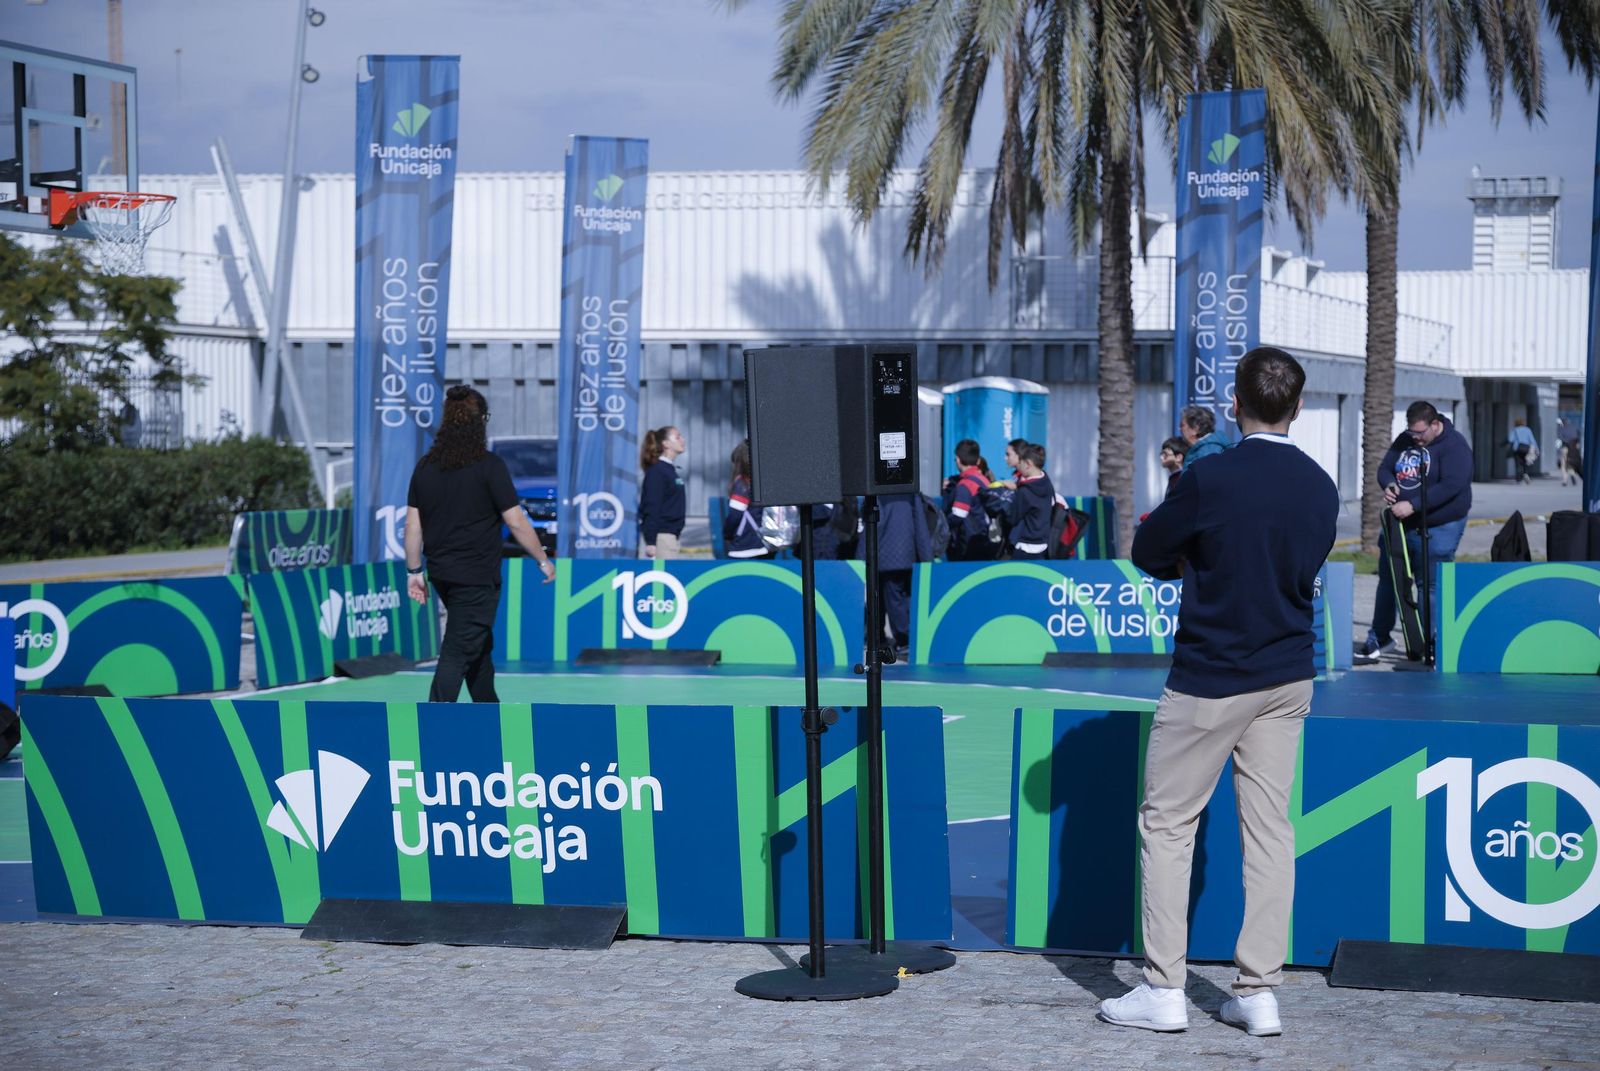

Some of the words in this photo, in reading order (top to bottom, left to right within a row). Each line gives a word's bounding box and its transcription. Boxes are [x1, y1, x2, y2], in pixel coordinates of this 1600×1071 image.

[369, 142, 452, 161] Fundación
[381, 159, 442, 180] Unicaja
[1187, 168, 1260, 187] Fundación
[1197, 183, 1250, 201] Unicaja
[574, 204, 642, 221] Fundación
[582, 218, 632, 235] Unicaja
[375, 257, 408, 346] años
[409, 261, 439, 374] ilusión
[1191, 271, 1217, 350] años
[576, 296, 603, 367] años
[1218, 274, 1248, 374] ilusión
[602, 299, 629, 391] ilusión
[375, 353, 408, 428] diez
[409, 382, 435, 428] de
[573, 376, 601, 432] diez
[600, 393, 626, 432] de
[572, 491, 625, 538] 10
[589, 508, 615, 521] años
[268, 543, 297, 568] diez
[297, 540, 331, 566] años
[345, 584, 401, 616] Fundación
[612, 570, 689, 641] 10
[636, 596, 675, 614] años
[1048, 577, 1112, 607] diez
[14, 629, 53, 649] años
[347, 611, 389, 642] Unicaja
[1047, 609, 1086, 637] de
[388, 759, 664, 813] Fundación
[392, 811, 588, 874] Unicaja
[1416, 756, 1600, 930] 10
[1484, 820, 1585, 863] años
